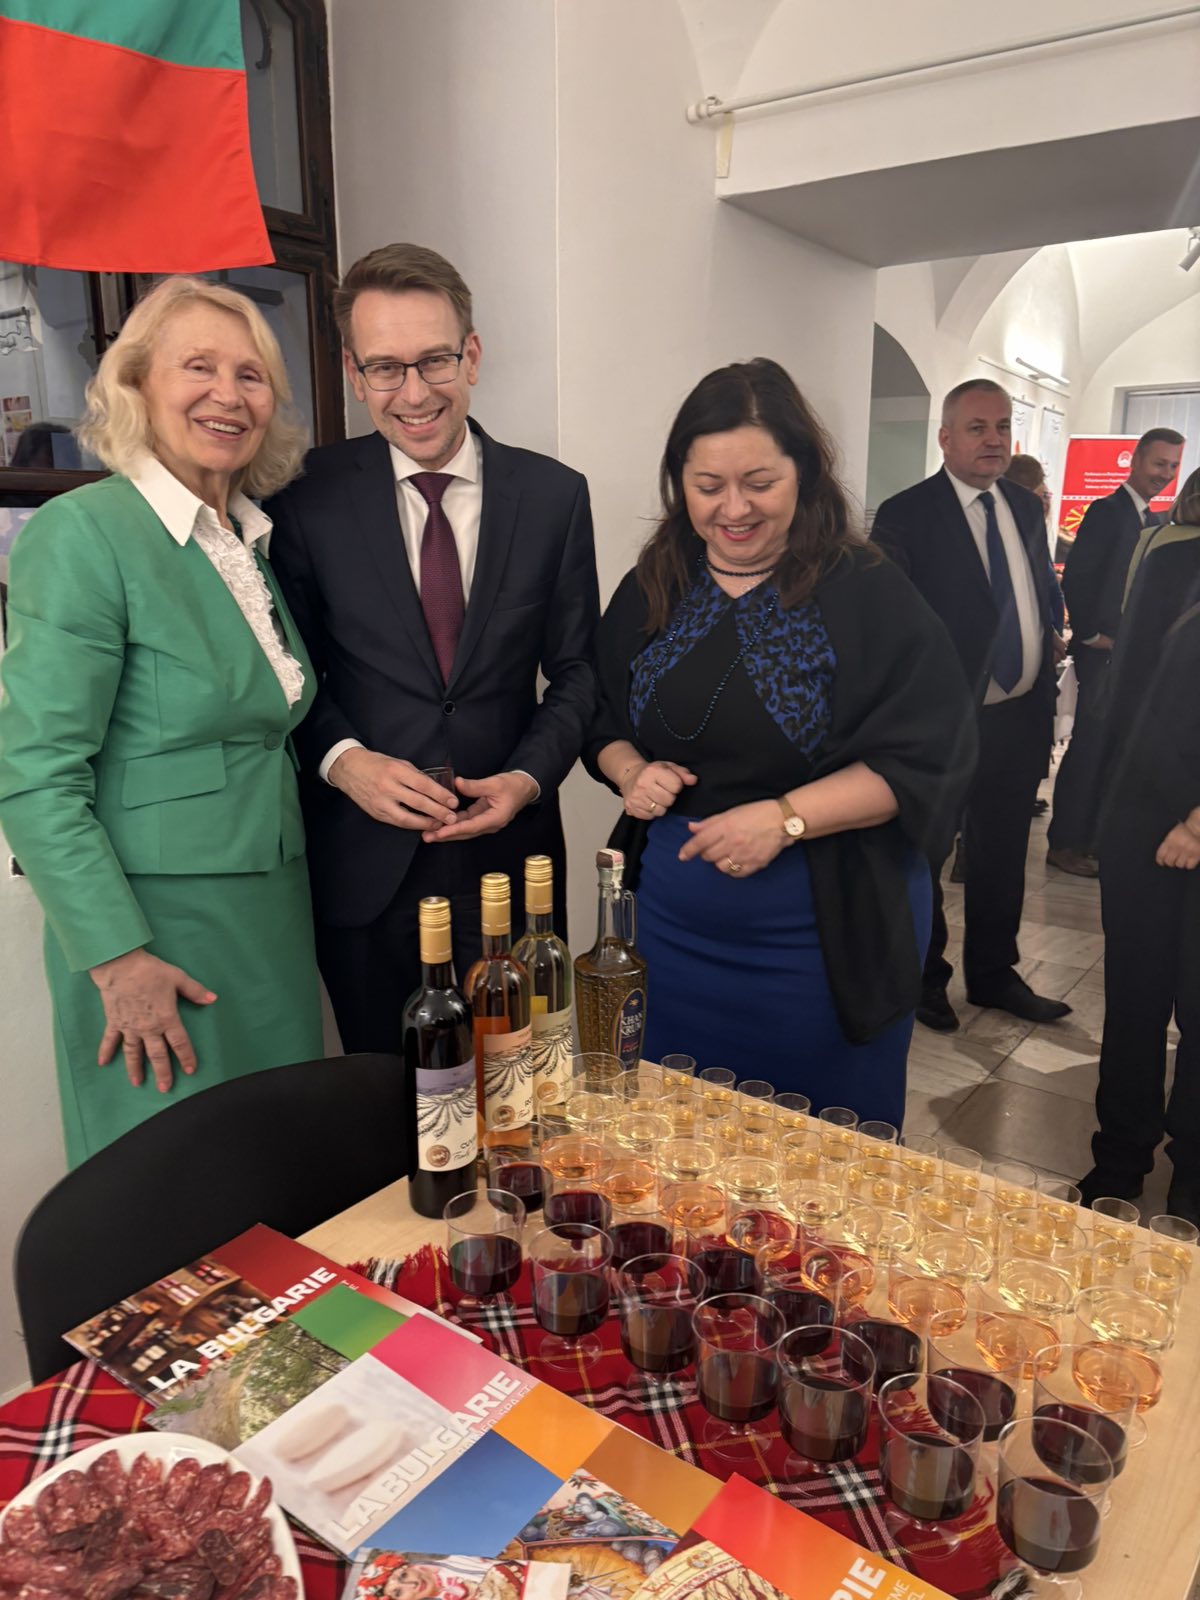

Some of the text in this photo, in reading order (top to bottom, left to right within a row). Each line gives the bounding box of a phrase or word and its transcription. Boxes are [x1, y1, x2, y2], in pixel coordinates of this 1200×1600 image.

[146, 1266, 338, 1390] LA BULGARIE
[330, 1370, 521, 1541] LA BULGARIE
